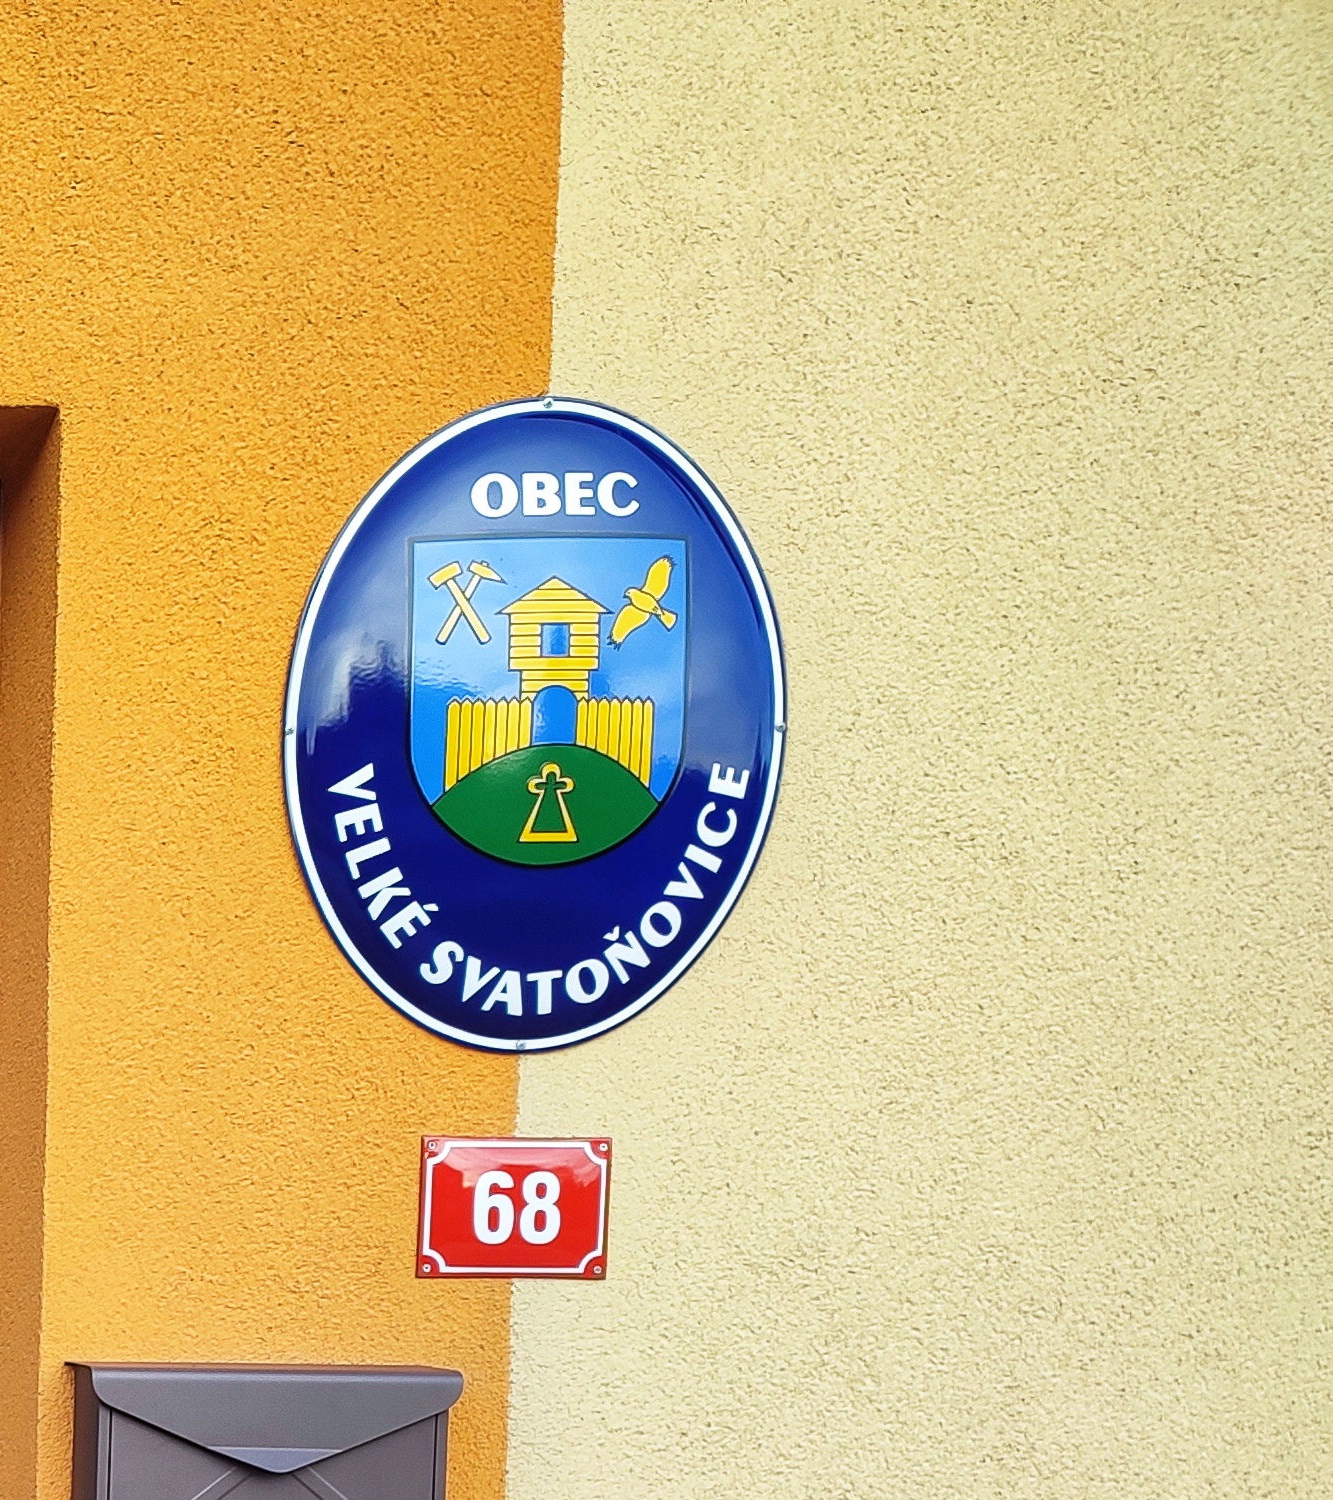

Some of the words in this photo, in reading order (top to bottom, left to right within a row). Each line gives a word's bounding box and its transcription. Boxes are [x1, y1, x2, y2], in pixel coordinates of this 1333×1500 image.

[470, 472, 640, 518] OBEC
[327, 762, 439, 950] VELKÉ
[420, 762, 751, 1017] SVATOŇOVICE
[472, 1169, 562, 1246] 68
